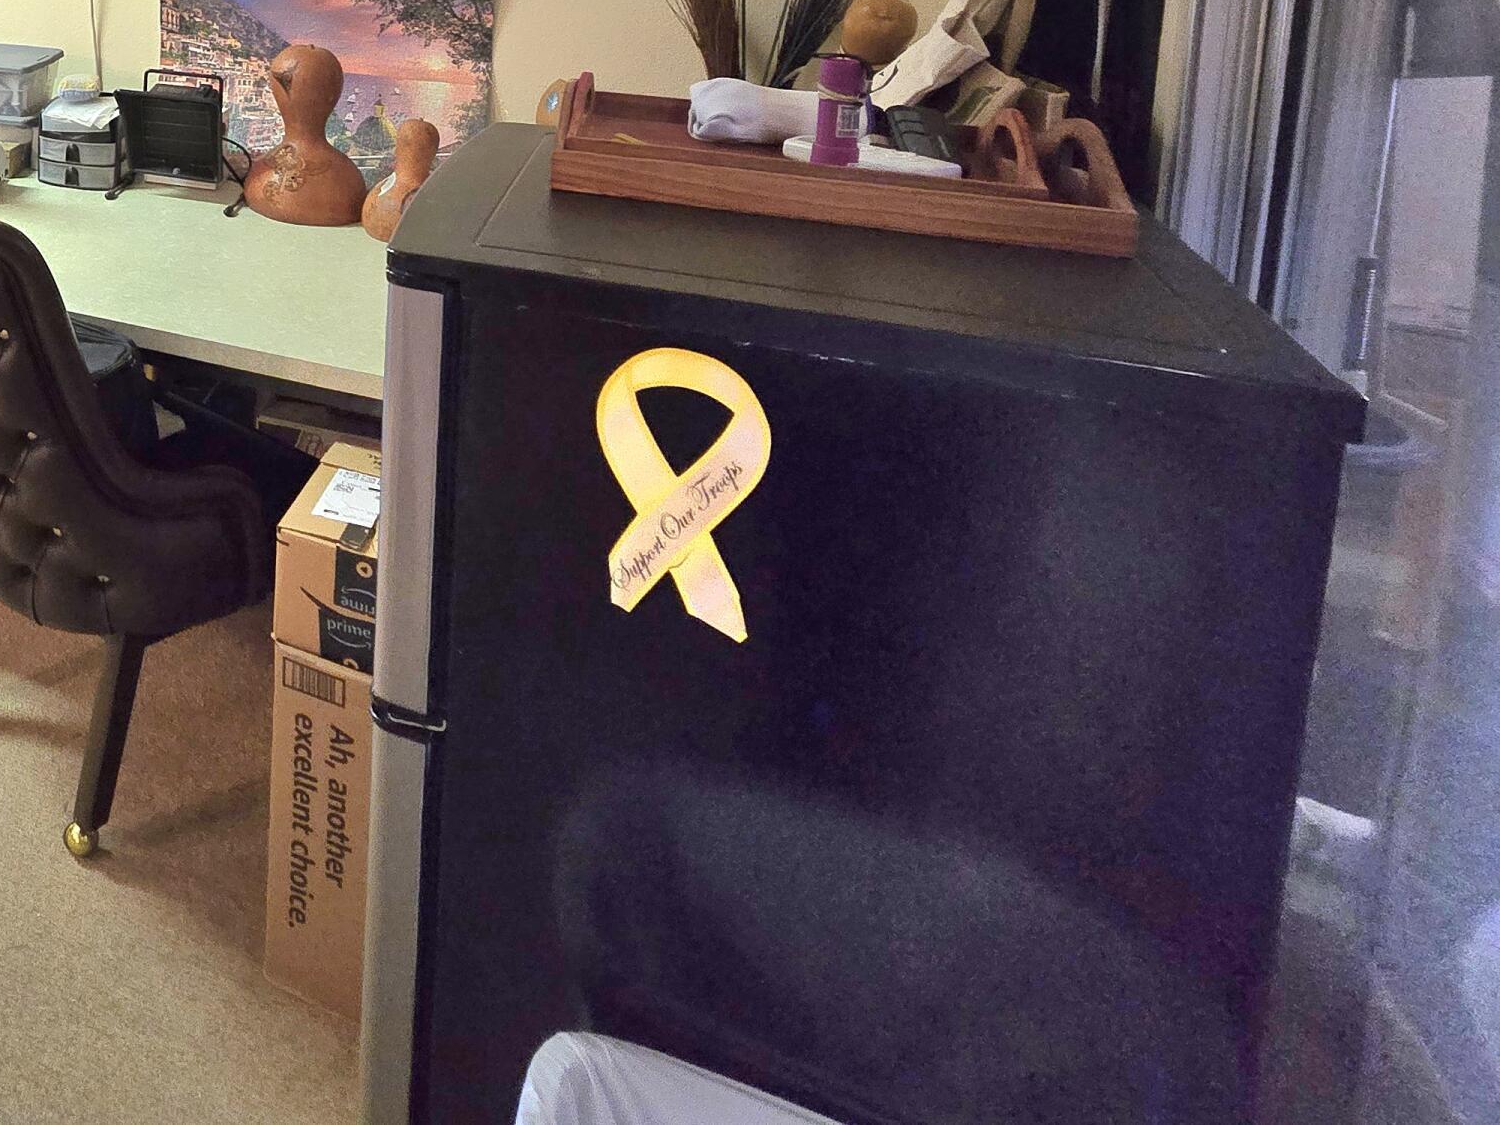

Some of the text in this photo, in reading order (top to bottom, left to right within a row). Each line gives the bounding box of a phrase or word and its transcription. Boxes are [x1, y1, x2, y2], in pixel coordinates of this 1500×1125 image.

[612, 462, 744, 592] Support Our Troops
[326, 617, 372, 639] prime
[288, 713, 318, 928] excellent choice.
[325, 724, 355, 889] Ah, another
